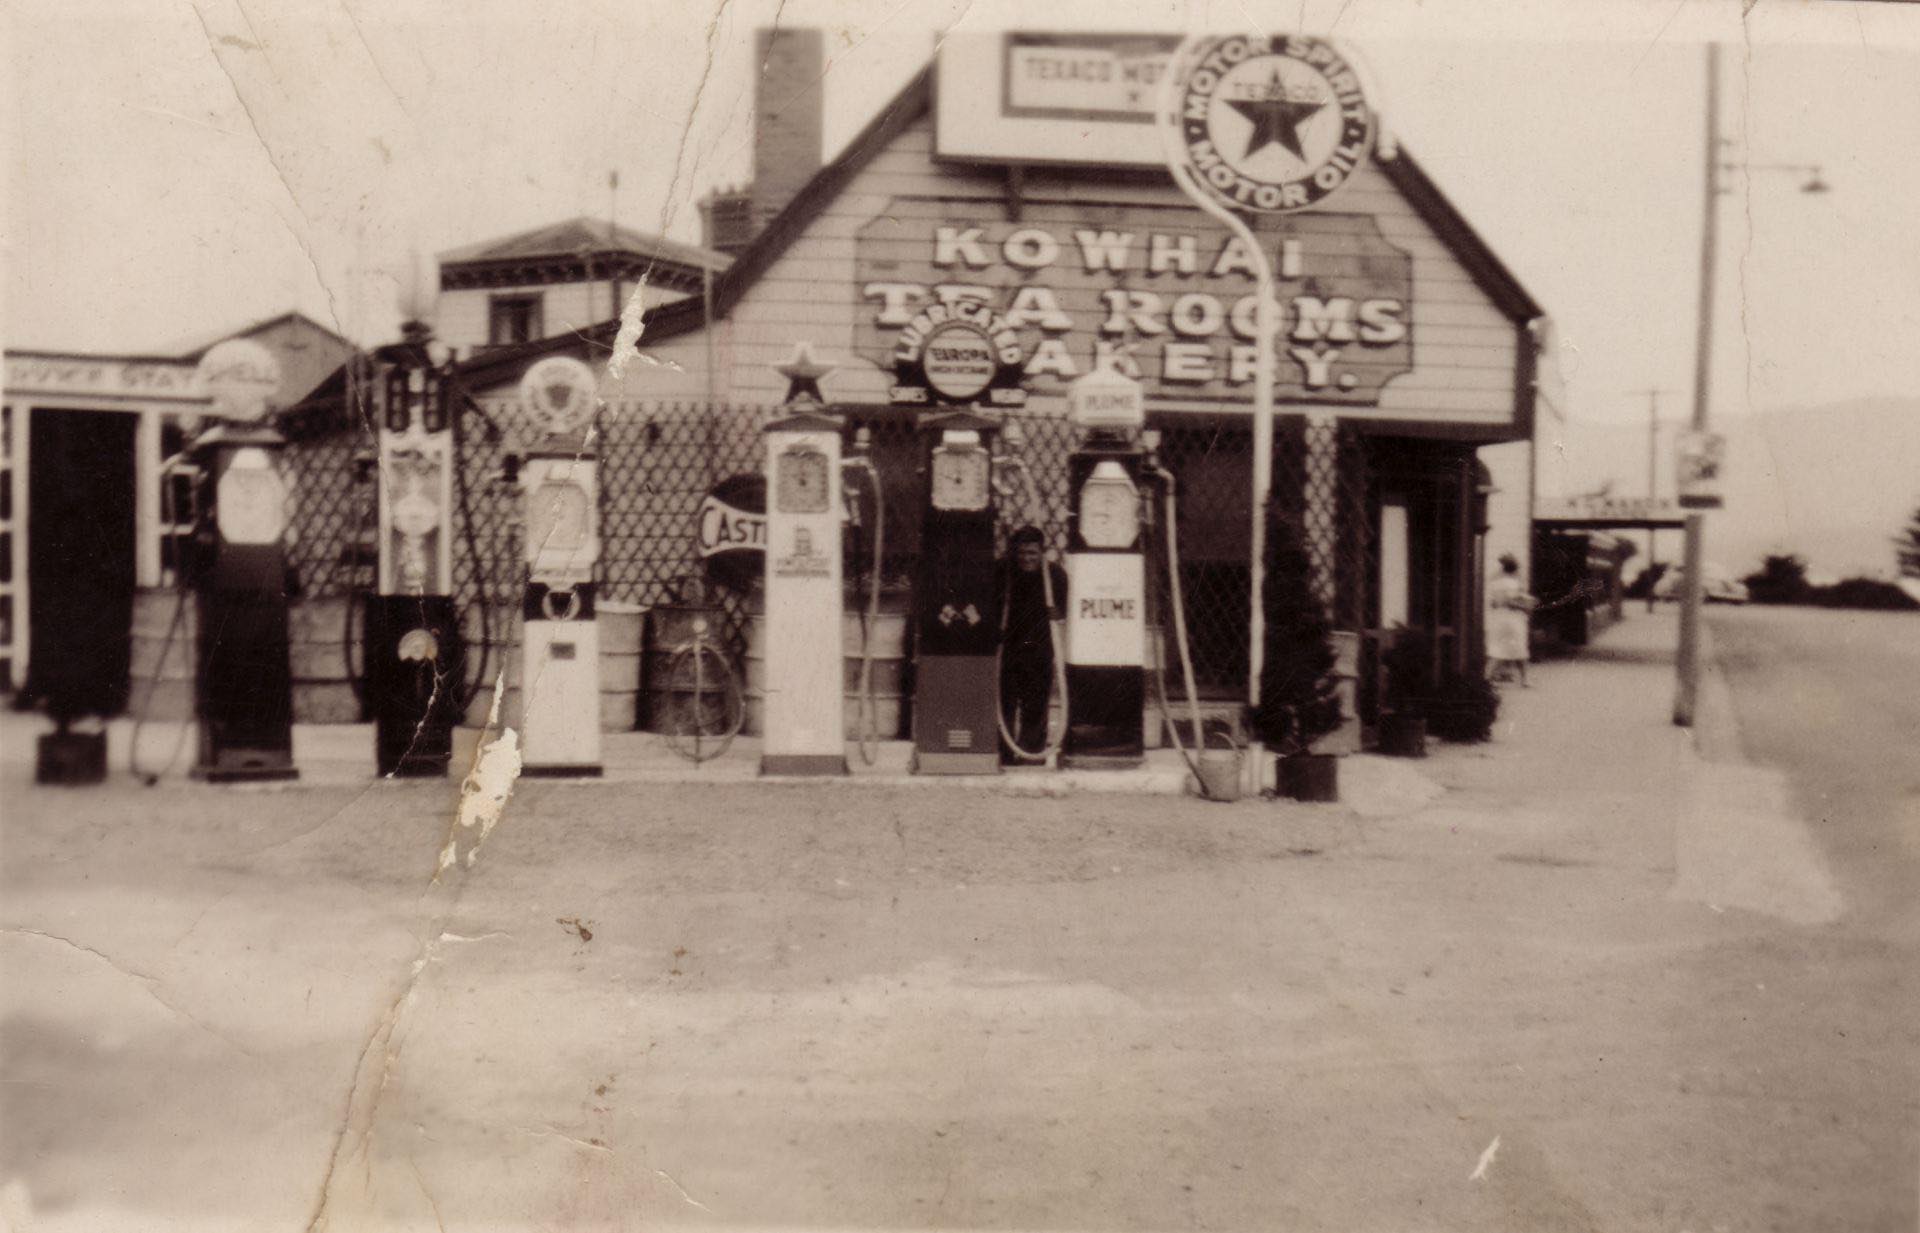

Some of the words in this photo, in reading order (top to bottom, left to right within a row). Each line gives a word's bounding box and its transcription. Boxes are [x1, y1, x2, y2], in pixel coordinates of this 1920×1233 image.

[1025, 56, 1113, 82] TEXACO
[1185, 37, 1270, 121] MOTOR
[1284, 37, 1368, 125] SPIRIT
[1188, 139, 1309, 210] MOTOR
[1313, 141, 1364, 190] OIL
[934, 227, 1301, 278] KOWHAI
[1024, 339, 1359, 388] AKEY.
[1085, 394, 1136, 410] PLUME
[699, 505, 767, 550] CAST
[1079, 597, 1136, 621] PLUME
